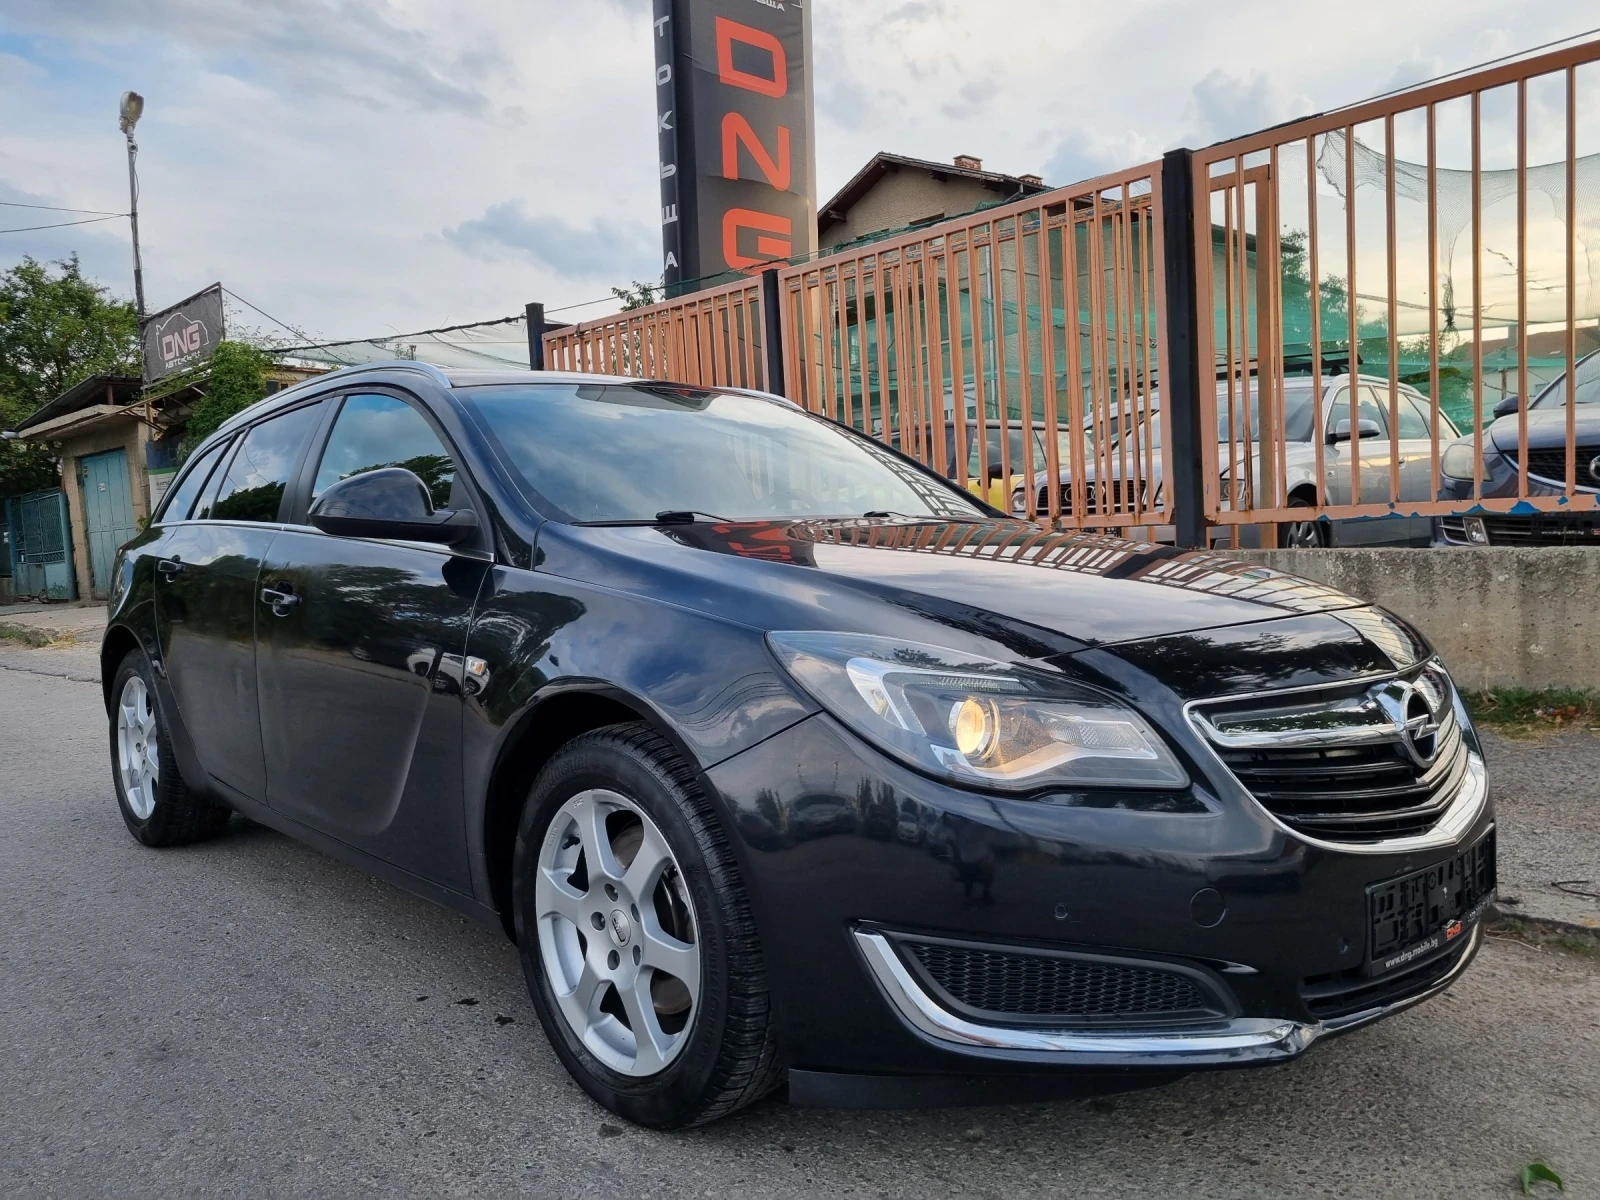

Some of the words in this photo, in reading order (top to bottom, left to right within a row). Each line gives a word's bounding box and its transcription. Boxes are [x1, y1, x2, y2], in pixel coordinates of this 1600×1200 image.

[716, 15, 792, 276] DNG
[162, 323, 200, 361] DNG
[1385, 938, 1438, 968] www.dng.mobile.bg
